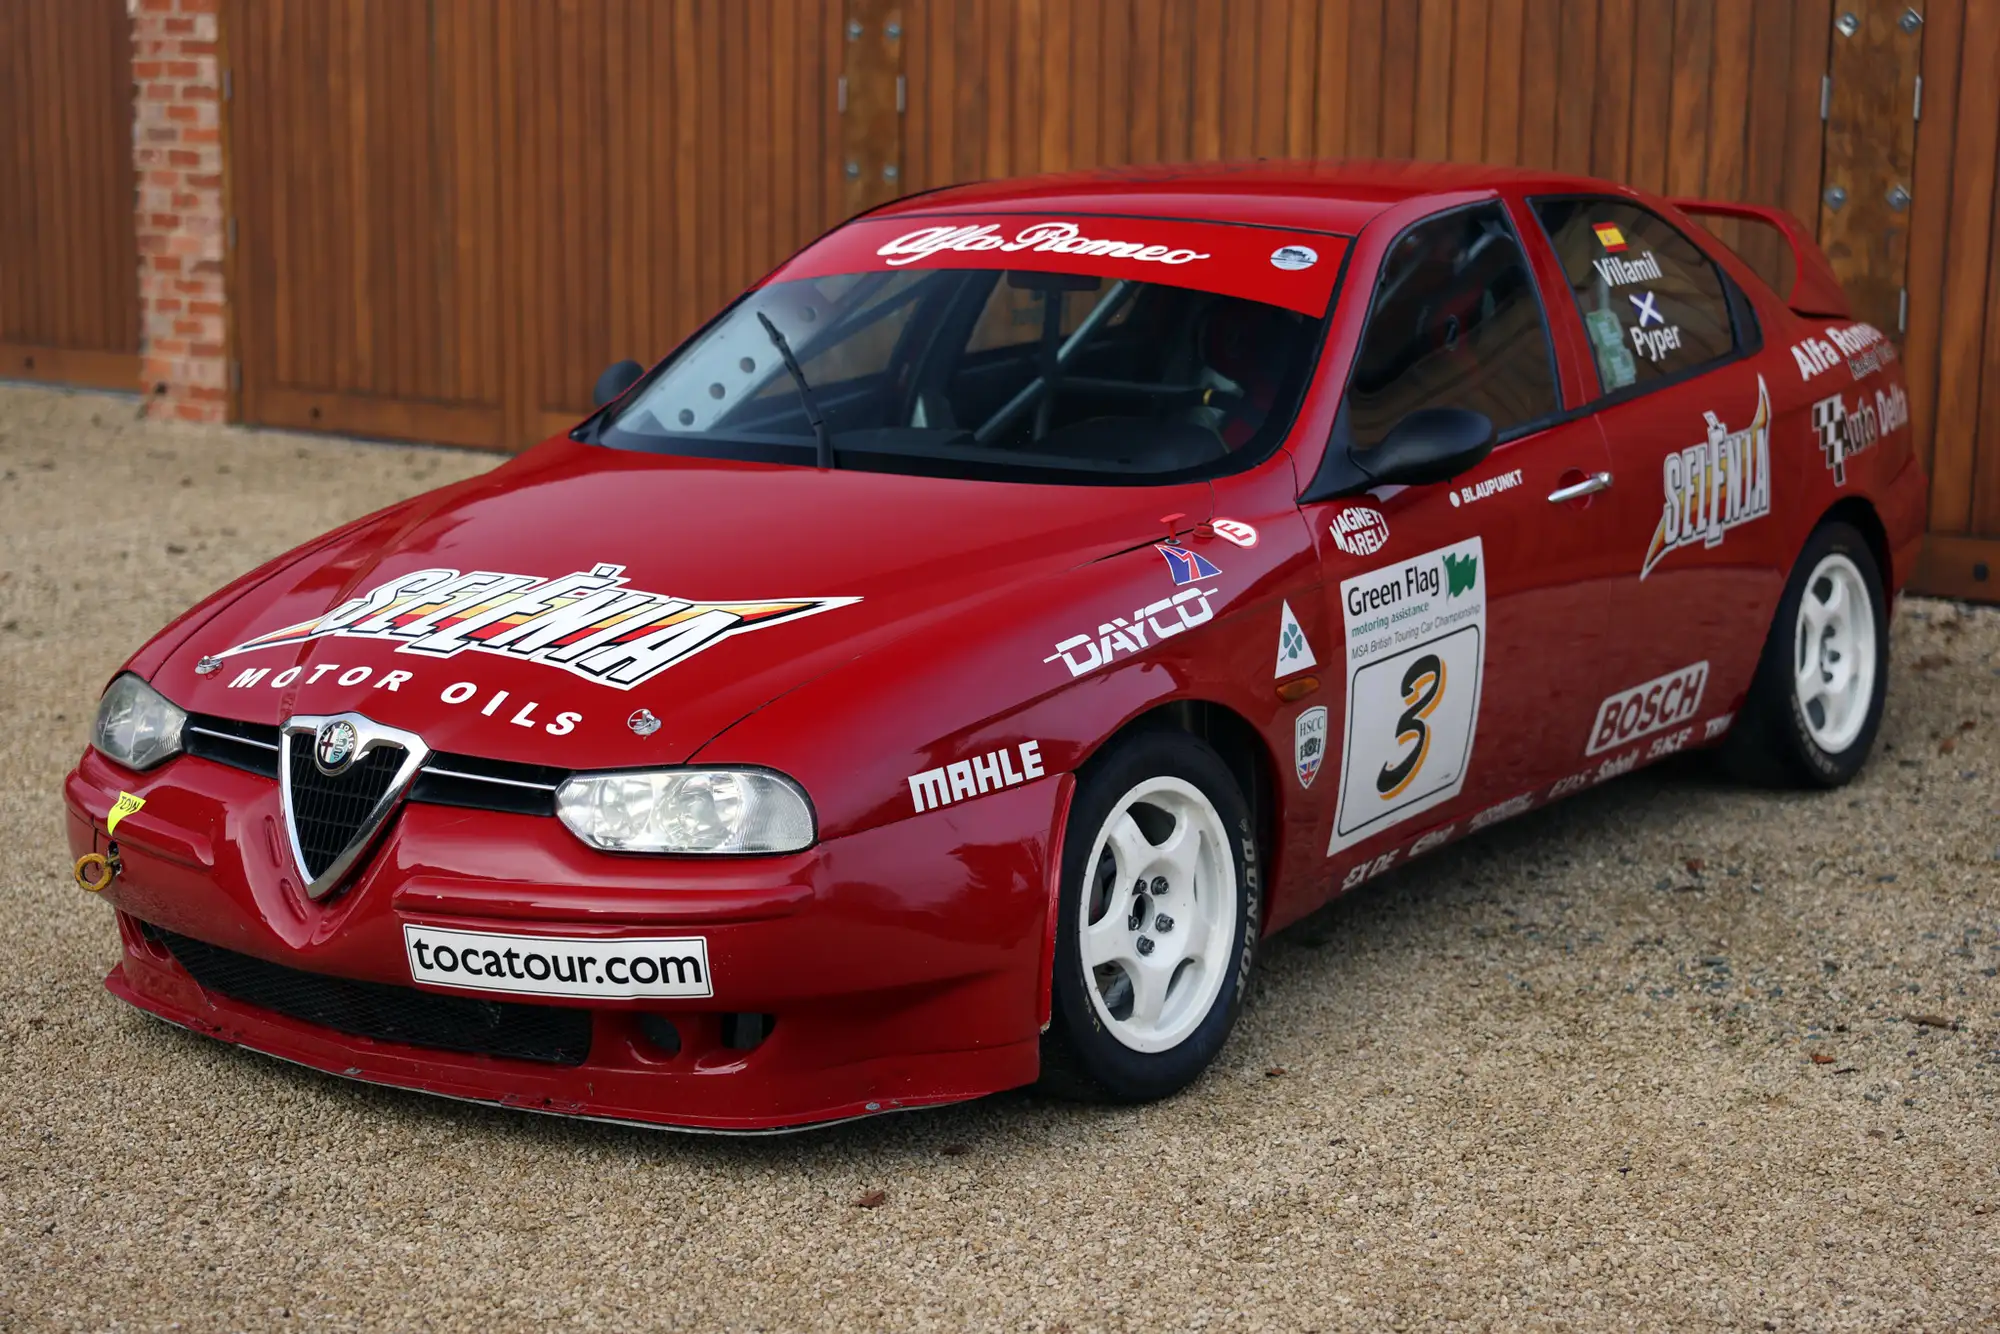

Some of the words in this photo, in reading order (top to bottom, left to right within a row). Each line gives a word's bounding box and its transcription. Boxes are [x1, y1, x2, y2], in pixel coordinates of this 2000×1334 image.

[877, 224, 1003, 265] Alfa
[1000, 222, 1210, 264] Romeo
[1592, 250, 1663, 287] Villamil
[1630, 325, 1681, 362] Pyper
[1790, 337, 1841, 382] Alfa
[1461, 469, 1523, 503] BLAUPUNKT
[1329, 507, 1389, 537] MAGNETI
[1329, 522, 1389, 556] MARELLI
[1347, 580, 1402, 617] Green
[1405, 566, 1439, 597] Flag
[1043, 587, 1219, 678] DAYCO
[1351, 616, 1389, 638] motoring
[1391, 602, 1430, 624] assistance
[1351, 644, 1369, 660] MSA
[1370, 635, 1393, 653] British
[1394, 626, 1419, 644] Touring
[1420, 620, 1434, 634] Car
[1434, 604, 1481, 628] Championship
[228, 662, 413, 692] MOTOR
[440, 680, 583, 736] OILS
[1300, 715, 1324, 738] HSCC
[1375, 653, 1447, 801] 3
[1593, 667, 1705, 751] BOSCH
[908, 740, 1045, 814] MAHLE
[115, 795, 141, 813] TOW
[412, 937, 703, 985] tocatour.com
